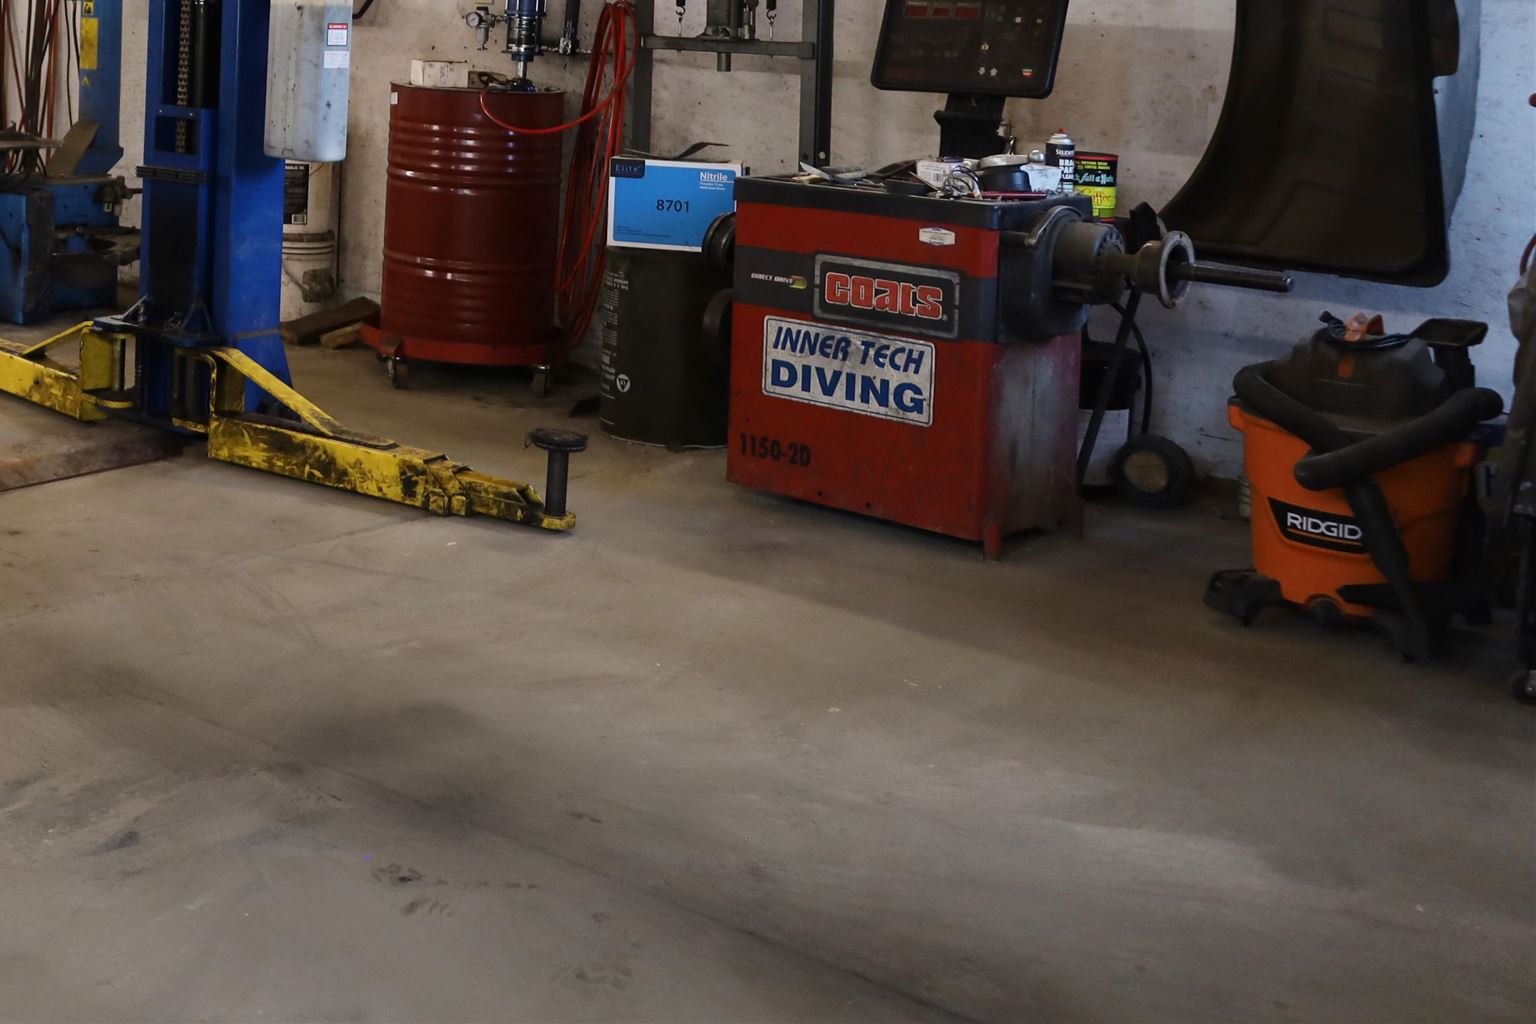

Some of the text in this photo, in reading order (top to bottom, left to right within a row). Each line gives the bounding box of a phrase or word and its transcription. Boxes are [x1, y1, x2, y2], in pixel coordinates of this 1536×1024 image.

[700, 171, 728, 181] Nitrile
[656, 199, 689, 212] 8701
[751, 272, 774, 281] DIRECT
[773, 326, 925, 375] INNER TECH
[770, 358, 926, 415] DIVING
[740, 432, 812, 467] 1150-2D
[1286, 512, 1363, 540] RIDGID
